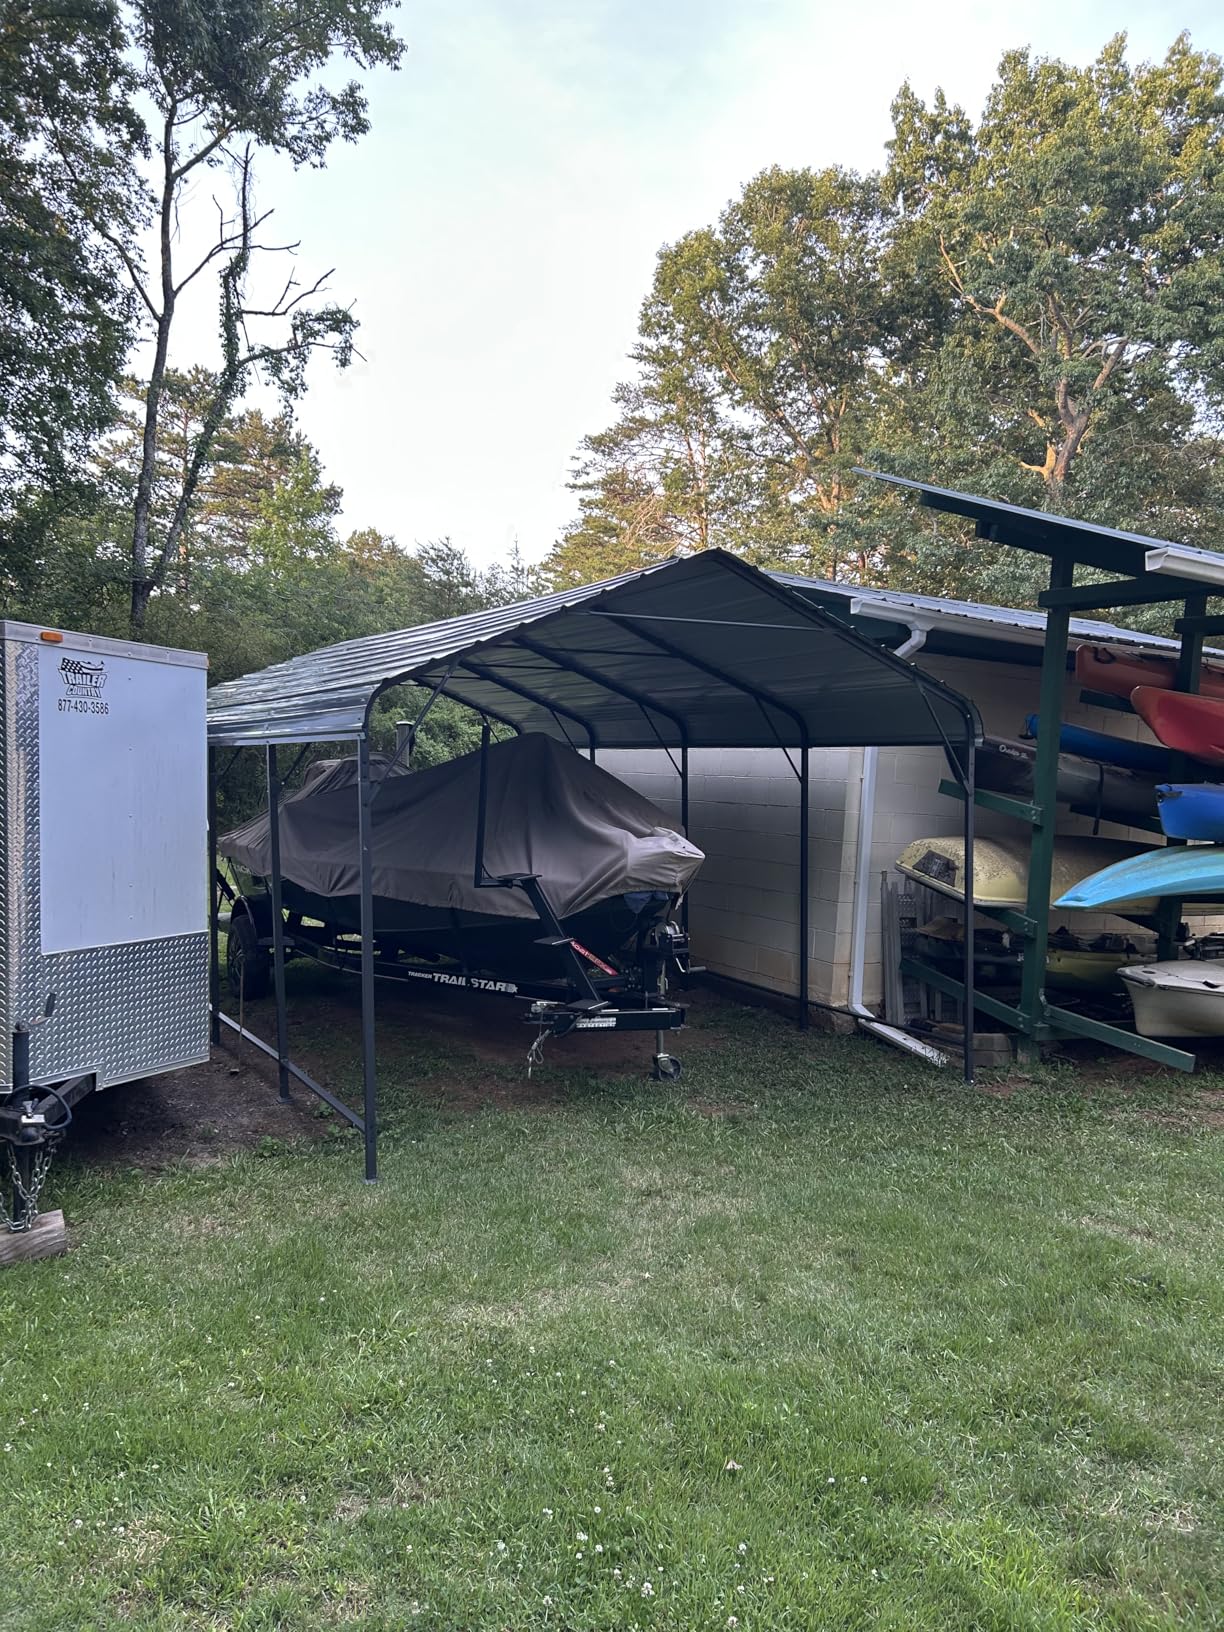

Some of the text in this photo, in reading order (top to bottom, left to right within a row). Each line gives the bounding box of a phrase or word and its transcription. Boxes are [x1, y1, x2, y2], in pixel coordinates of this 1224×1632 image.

[58, 669, 107, 688] TRAILER
[66, 685, 102, 698] COUNTRY
[57, 699, 109, 714] 877-430-3586
